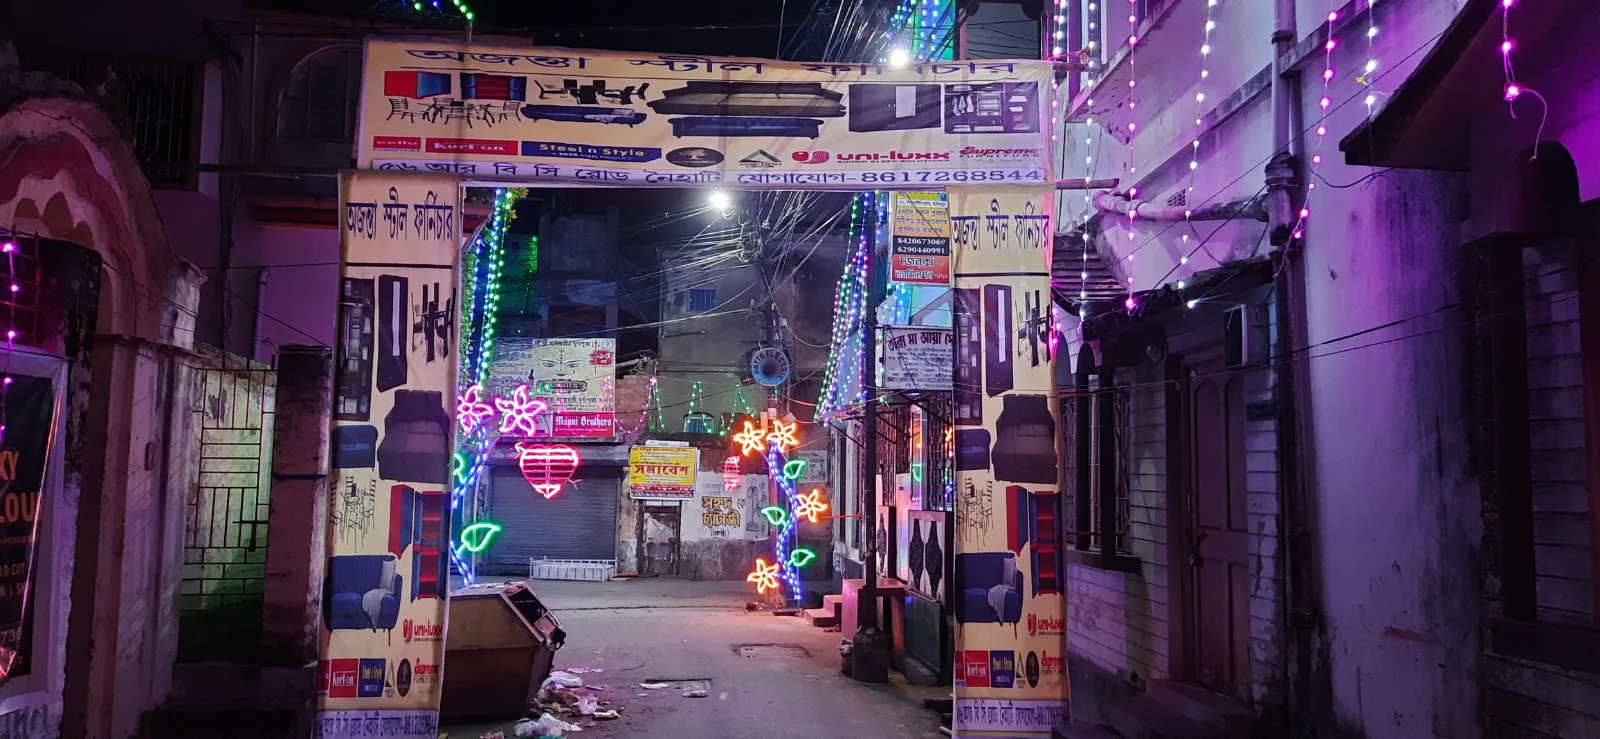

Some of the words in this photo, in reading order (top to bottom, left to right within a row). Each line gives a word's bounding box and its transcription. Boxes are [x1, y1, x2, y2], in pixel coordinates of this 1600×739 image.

[433, 142, 505, 151] Kurl-on
[539, 144, 583, 153] Steel
[602, 148, 645, 157] Style
[959, 146, 1039, 156] Supreme
[493, 162, 518, 175] বি
[533, 163, 560, 177] সি
[574, 168, 631, 181] রোড
[643, 169, 722, 184] নৈহাটি
[413, 190, 453, 241] ফার্নিচার
[1014, 201, 1050, 250] ফার্নিচার
[897, 246, 945, 254] 6290440991
[887, 335, 906, 351] তারা
[907, 333, 918, 345] মা
[580, 415, 612, 427] Brothers
[635, 464, 690, 476] সমাবেশ
[966, 662, 987, 677] Kurl-on
[332, 671, 354, 687] Kurl-on
